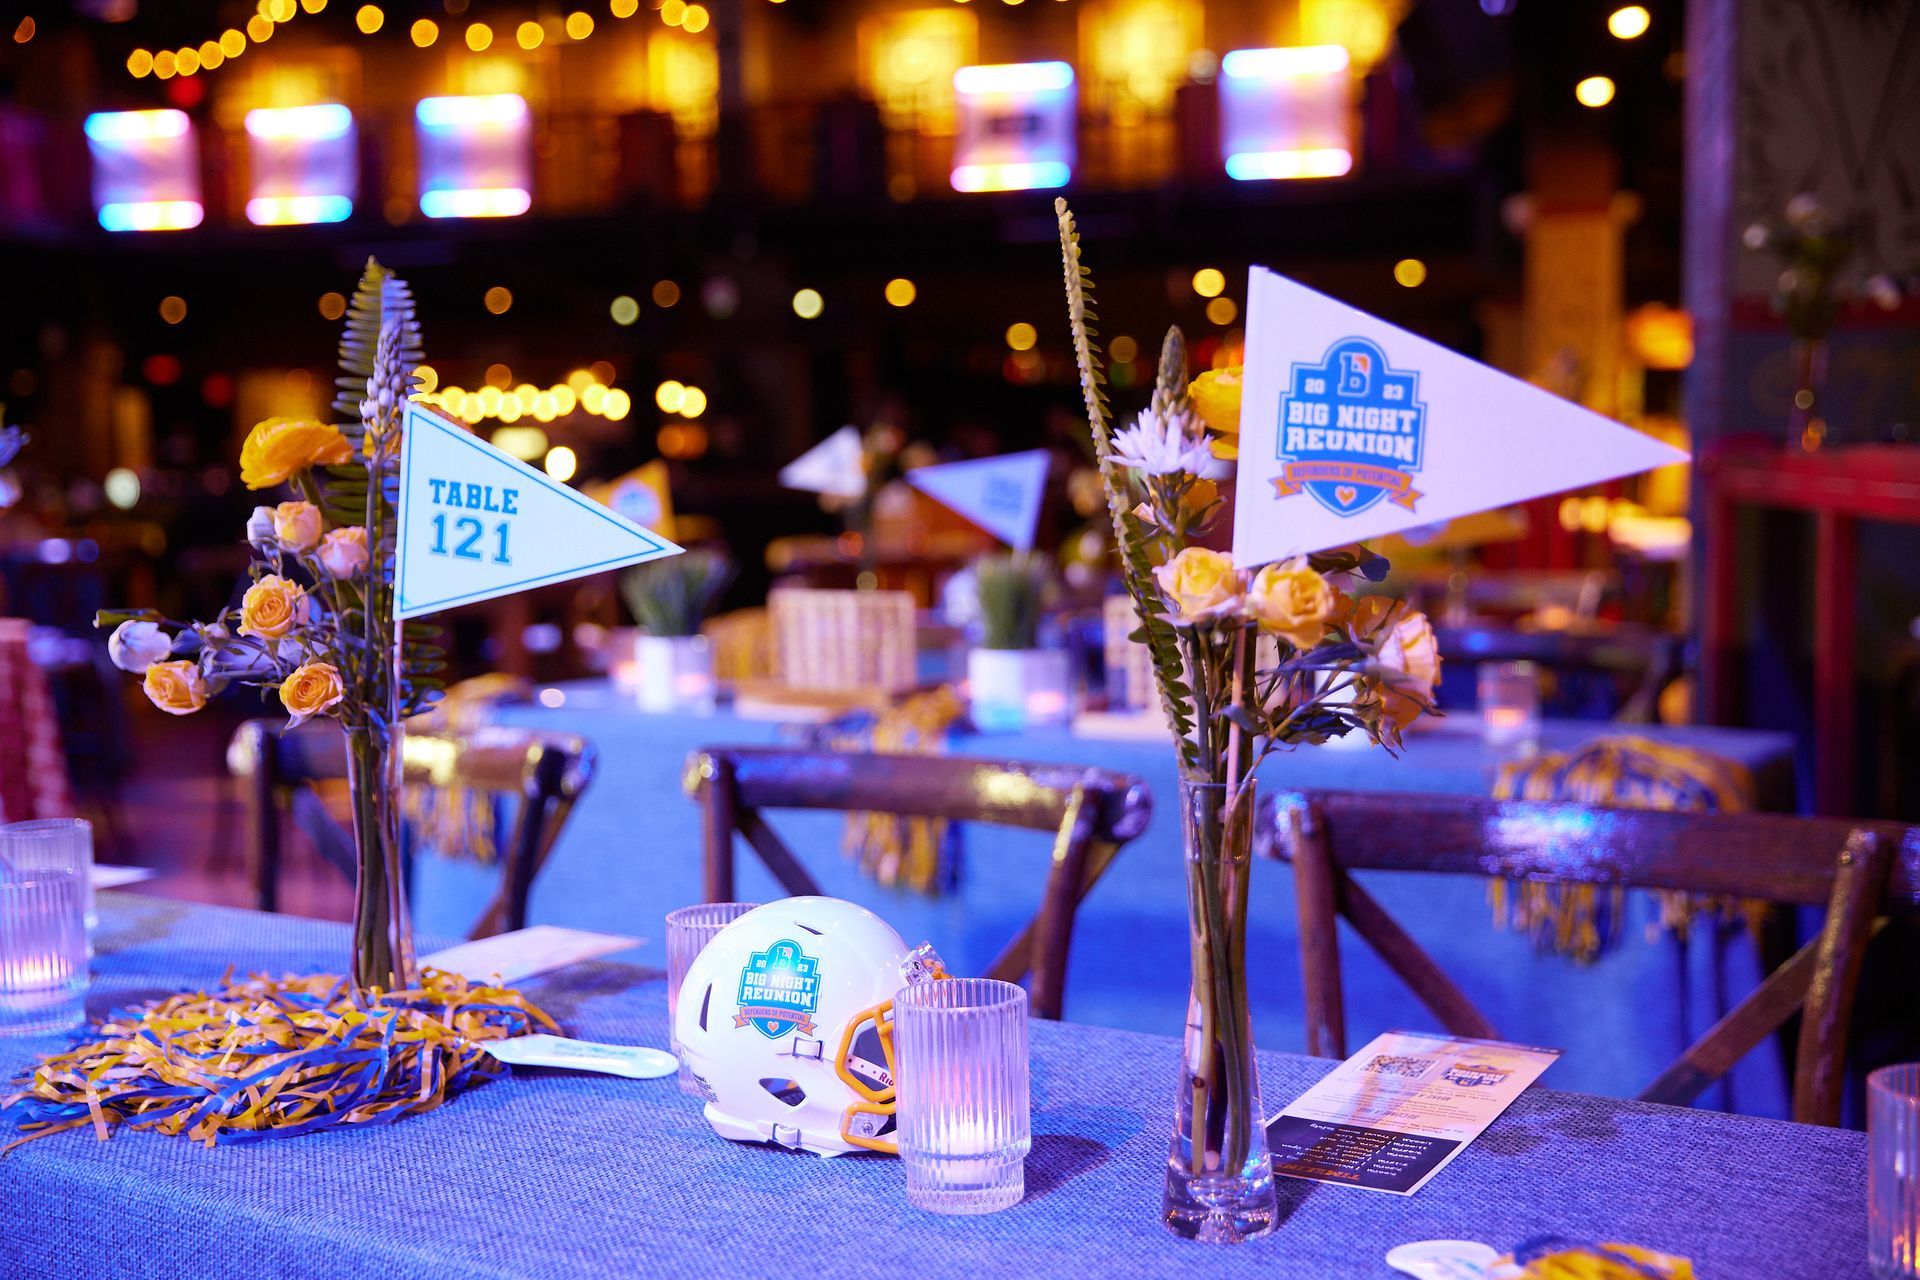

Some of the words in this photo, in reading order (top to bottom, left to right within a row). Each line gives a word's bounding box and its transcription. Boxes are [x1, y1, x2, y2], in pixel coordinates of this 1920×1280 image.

[1304, 378, 1325, 394] 20
[1382, 384, 1404, 400] 23
[1287, 401, 1329, 426] BIG
[1336, 405, 1417, 433] NIGHT
[1286, 426, 1415, 462] REUNION
[1292, 466, 1340, 477] DEFENDERS
[1344, 466, 1353, 477] OF
[429, 478, 518, 515] TABLE
[428, 512, 511, 566] 121
[756, 959, 767, 968] 20
[797, 963, 809, 973] 23
[745, 972, 767, 986] BIG
[771, 974, 814, 991] NIGHT
[742, 986, 812, 1007] REUNION
[744, 1008, 771, 1016] DEFENDERS
[779, 1010, 805, 1021] POTENTIAL
